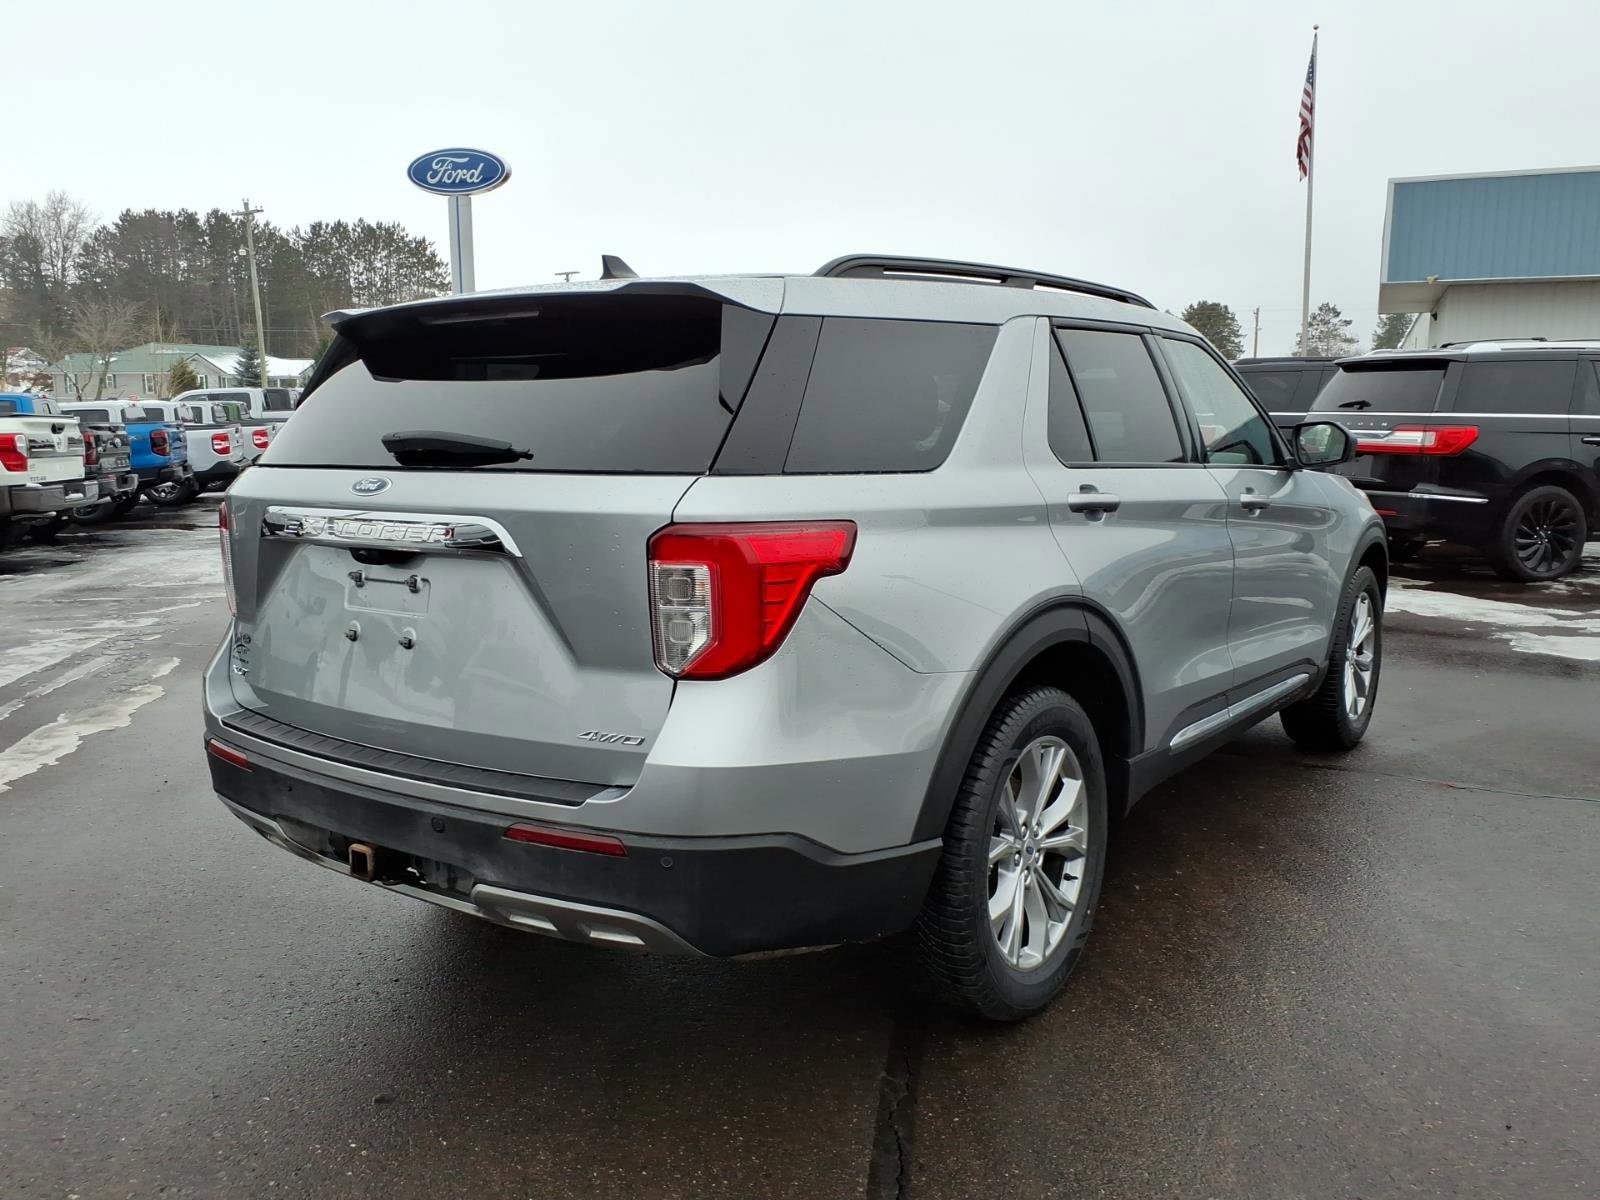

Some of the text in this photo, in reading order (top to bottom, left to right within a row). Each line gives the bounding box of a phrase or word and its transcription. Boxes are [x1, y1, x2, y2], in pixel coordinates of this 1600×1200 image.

[426, 157, 484, 184] Ford
[355, 478, 382, 490] Ford
[284, 517, 455, 543] EXPLORER
[577, 731, 645, 746] 4WD
